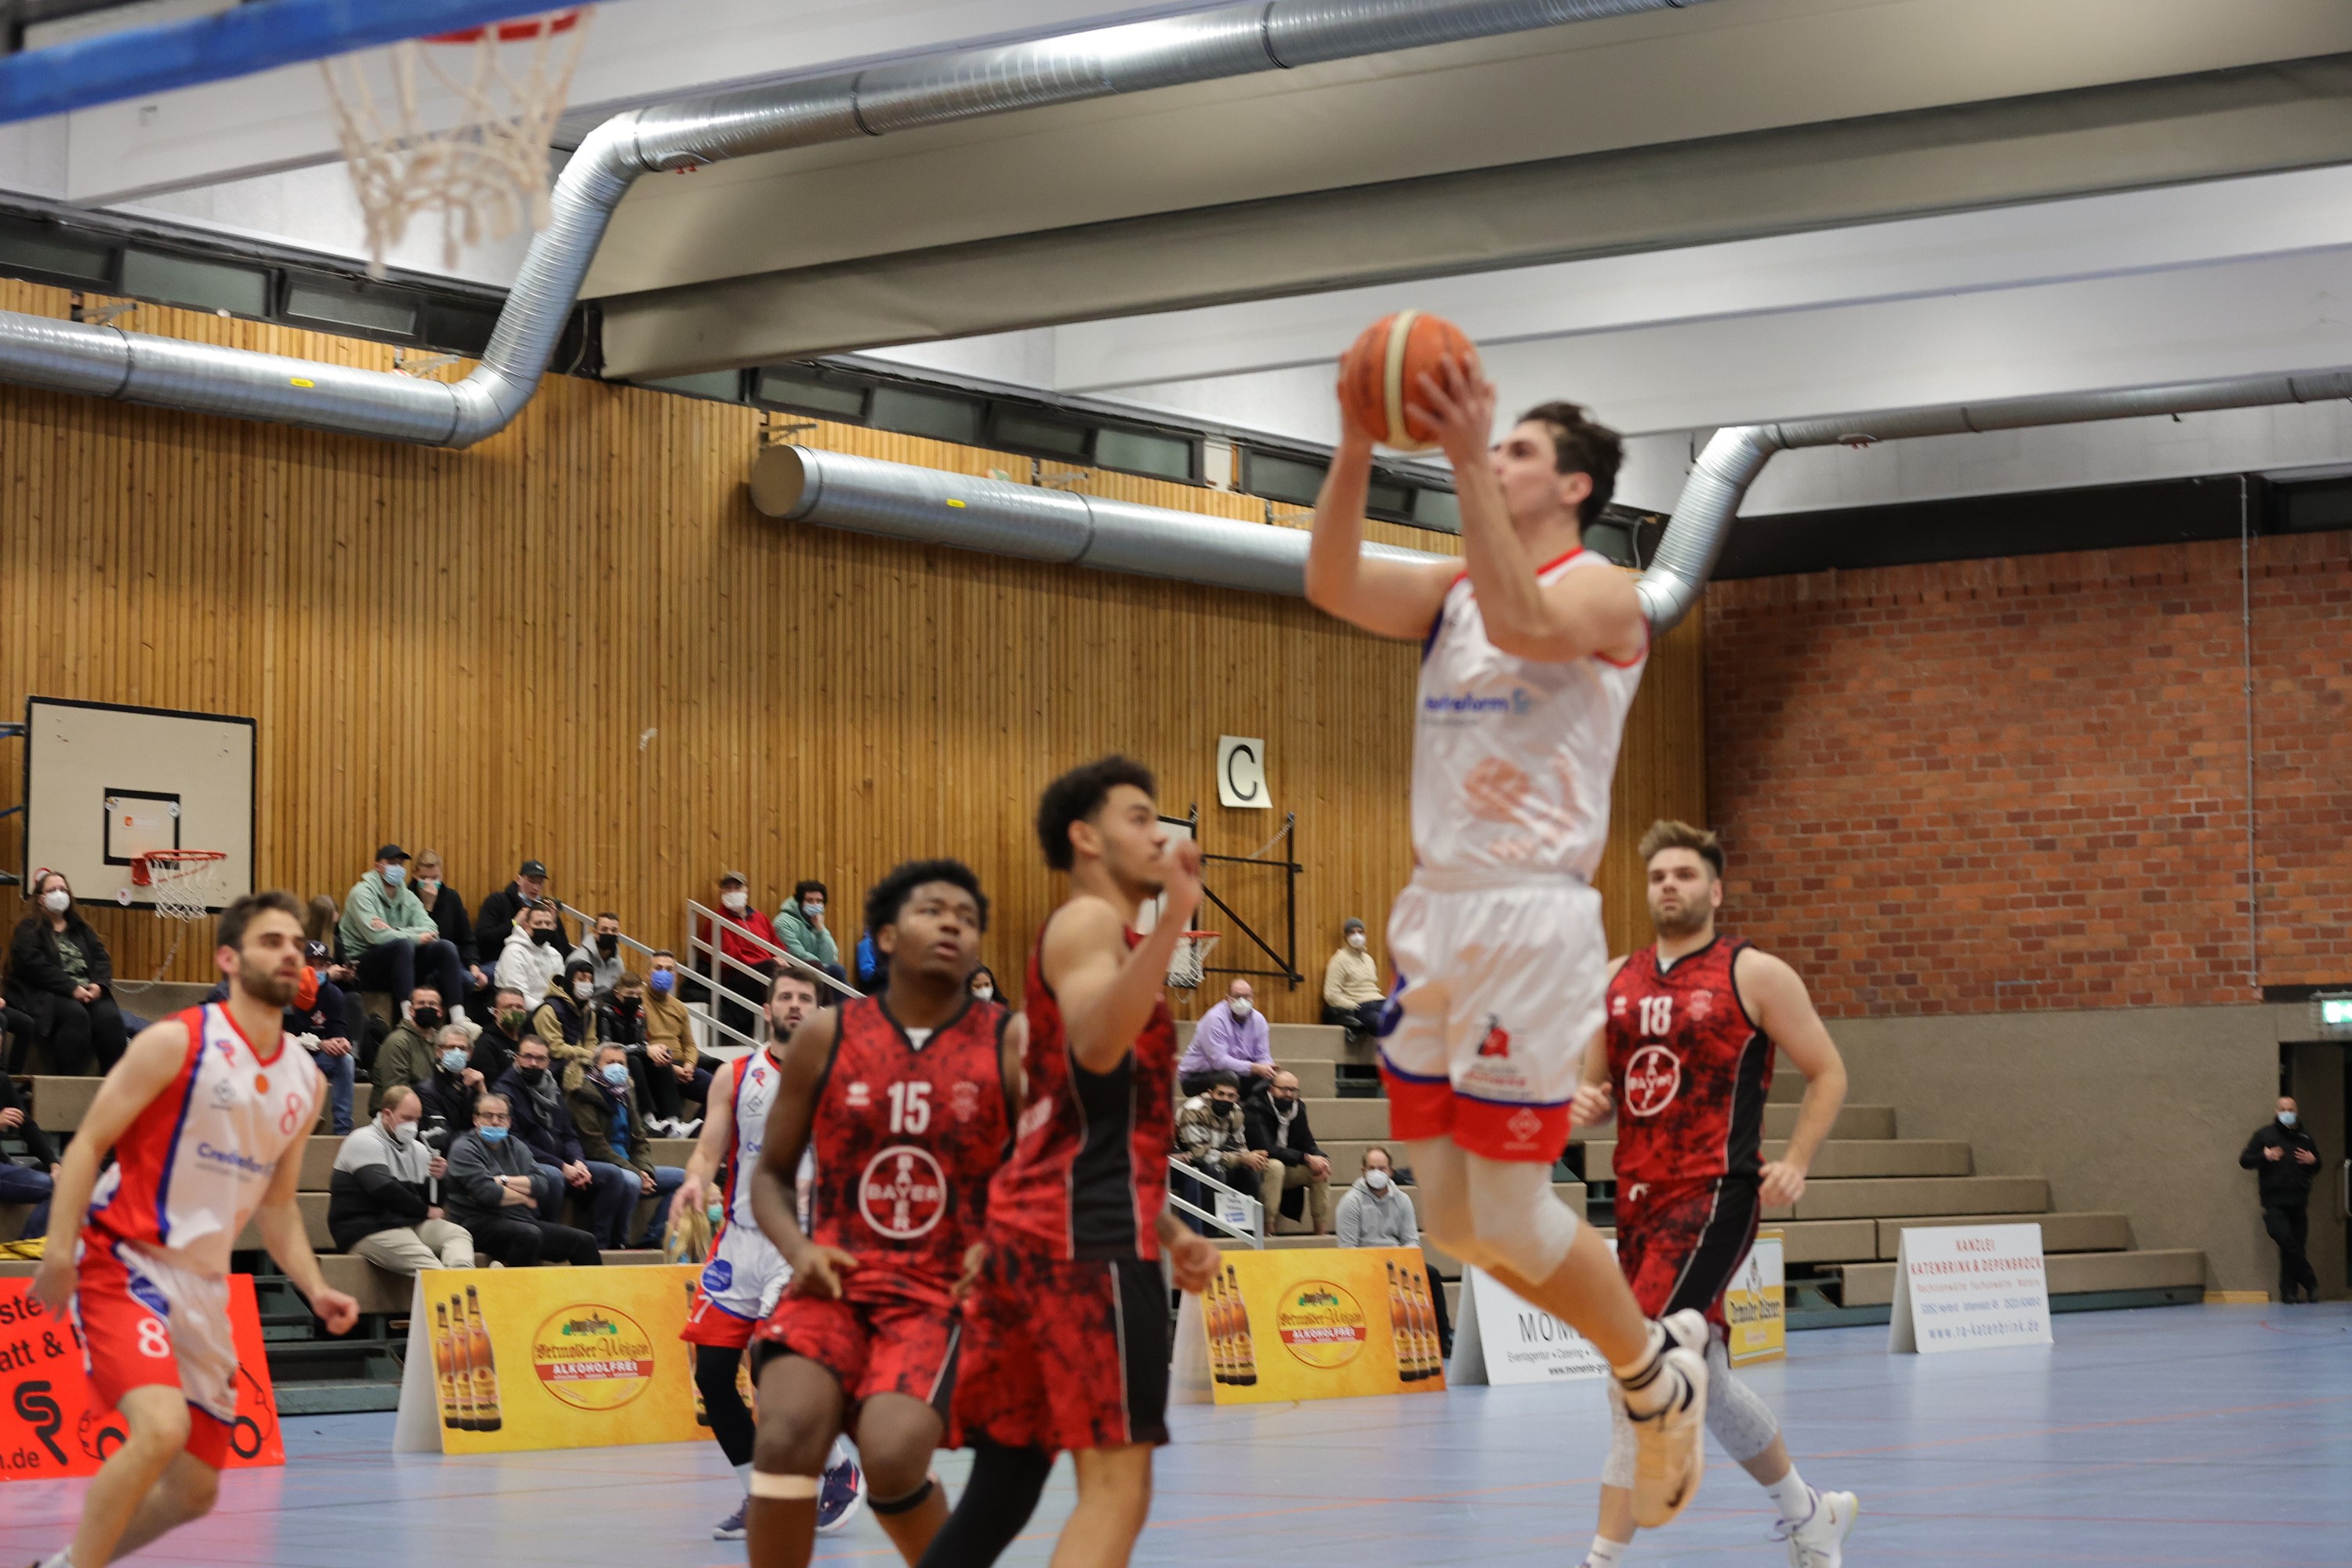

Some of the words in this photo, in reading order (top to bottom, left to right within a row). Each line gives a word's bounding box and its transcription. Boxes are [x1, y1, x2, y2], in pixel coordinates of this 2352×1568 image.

[1228, 744, 1258, 801] C
[1638, 995, 1673, 1036] 18
[279, 1091, 303, 1135] 8
[887, 1080, 932, 1134] 15
[1956, 1238, 1995, 1252] KANZLEI
[1910, 1260, 1972, 1276] KATENBRINK
[1973, 1258, 1980, 1272] &
[1981, 1257, 2041, 1272] DEPENBROCK
[42, 1331, 64, 1359] &
[136, 1317, 170, 1359] 8
[1292, 1327, 1356, 1340] ALKOHOLFREI
[553, 1361, 639, 1375] ALKOHOLFREI
